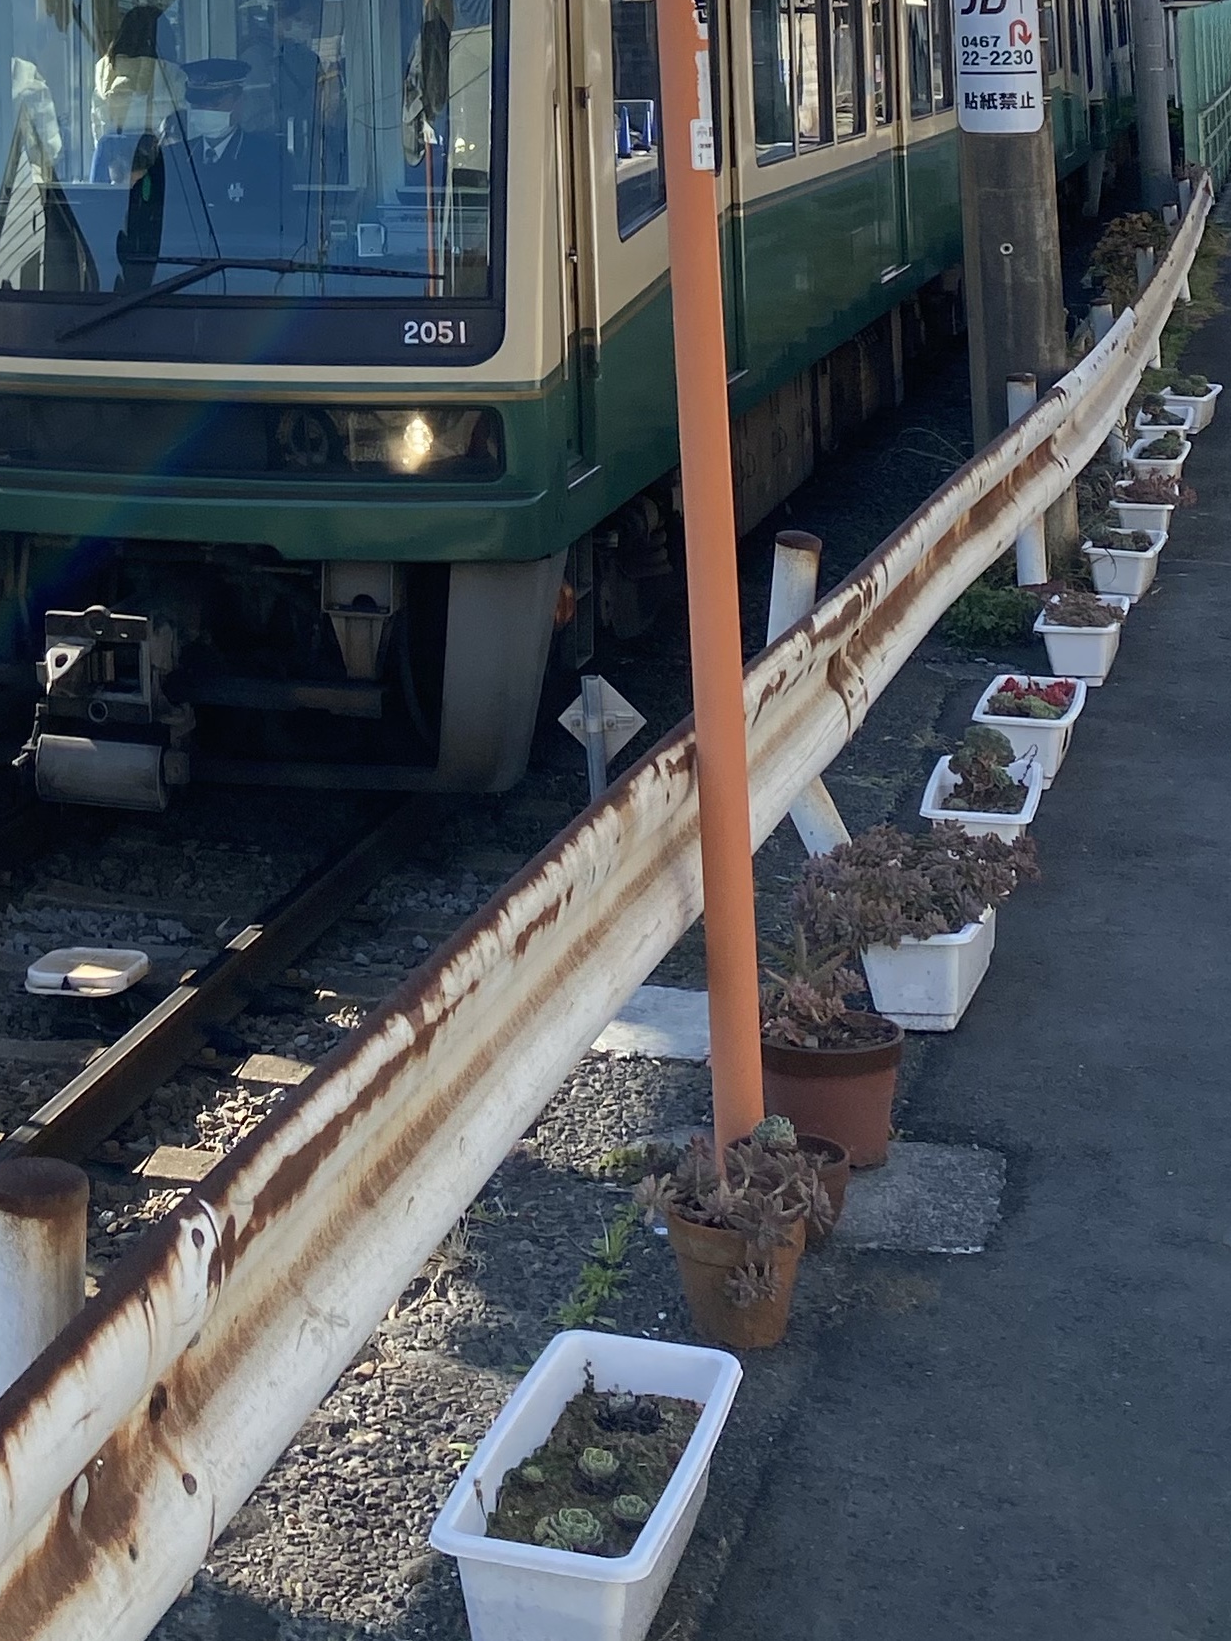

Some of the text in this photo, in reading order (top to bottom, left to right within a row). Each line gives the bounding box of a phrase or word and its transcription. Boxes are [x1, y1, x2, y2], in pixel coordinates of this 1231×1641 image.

[961, 35, 1001, 48] 0467
[962, 49, 1034, 66] 22-2230
[964, 91, 1036, 110] 貼紙禁止
[404, 321, 466, 344] 2051
